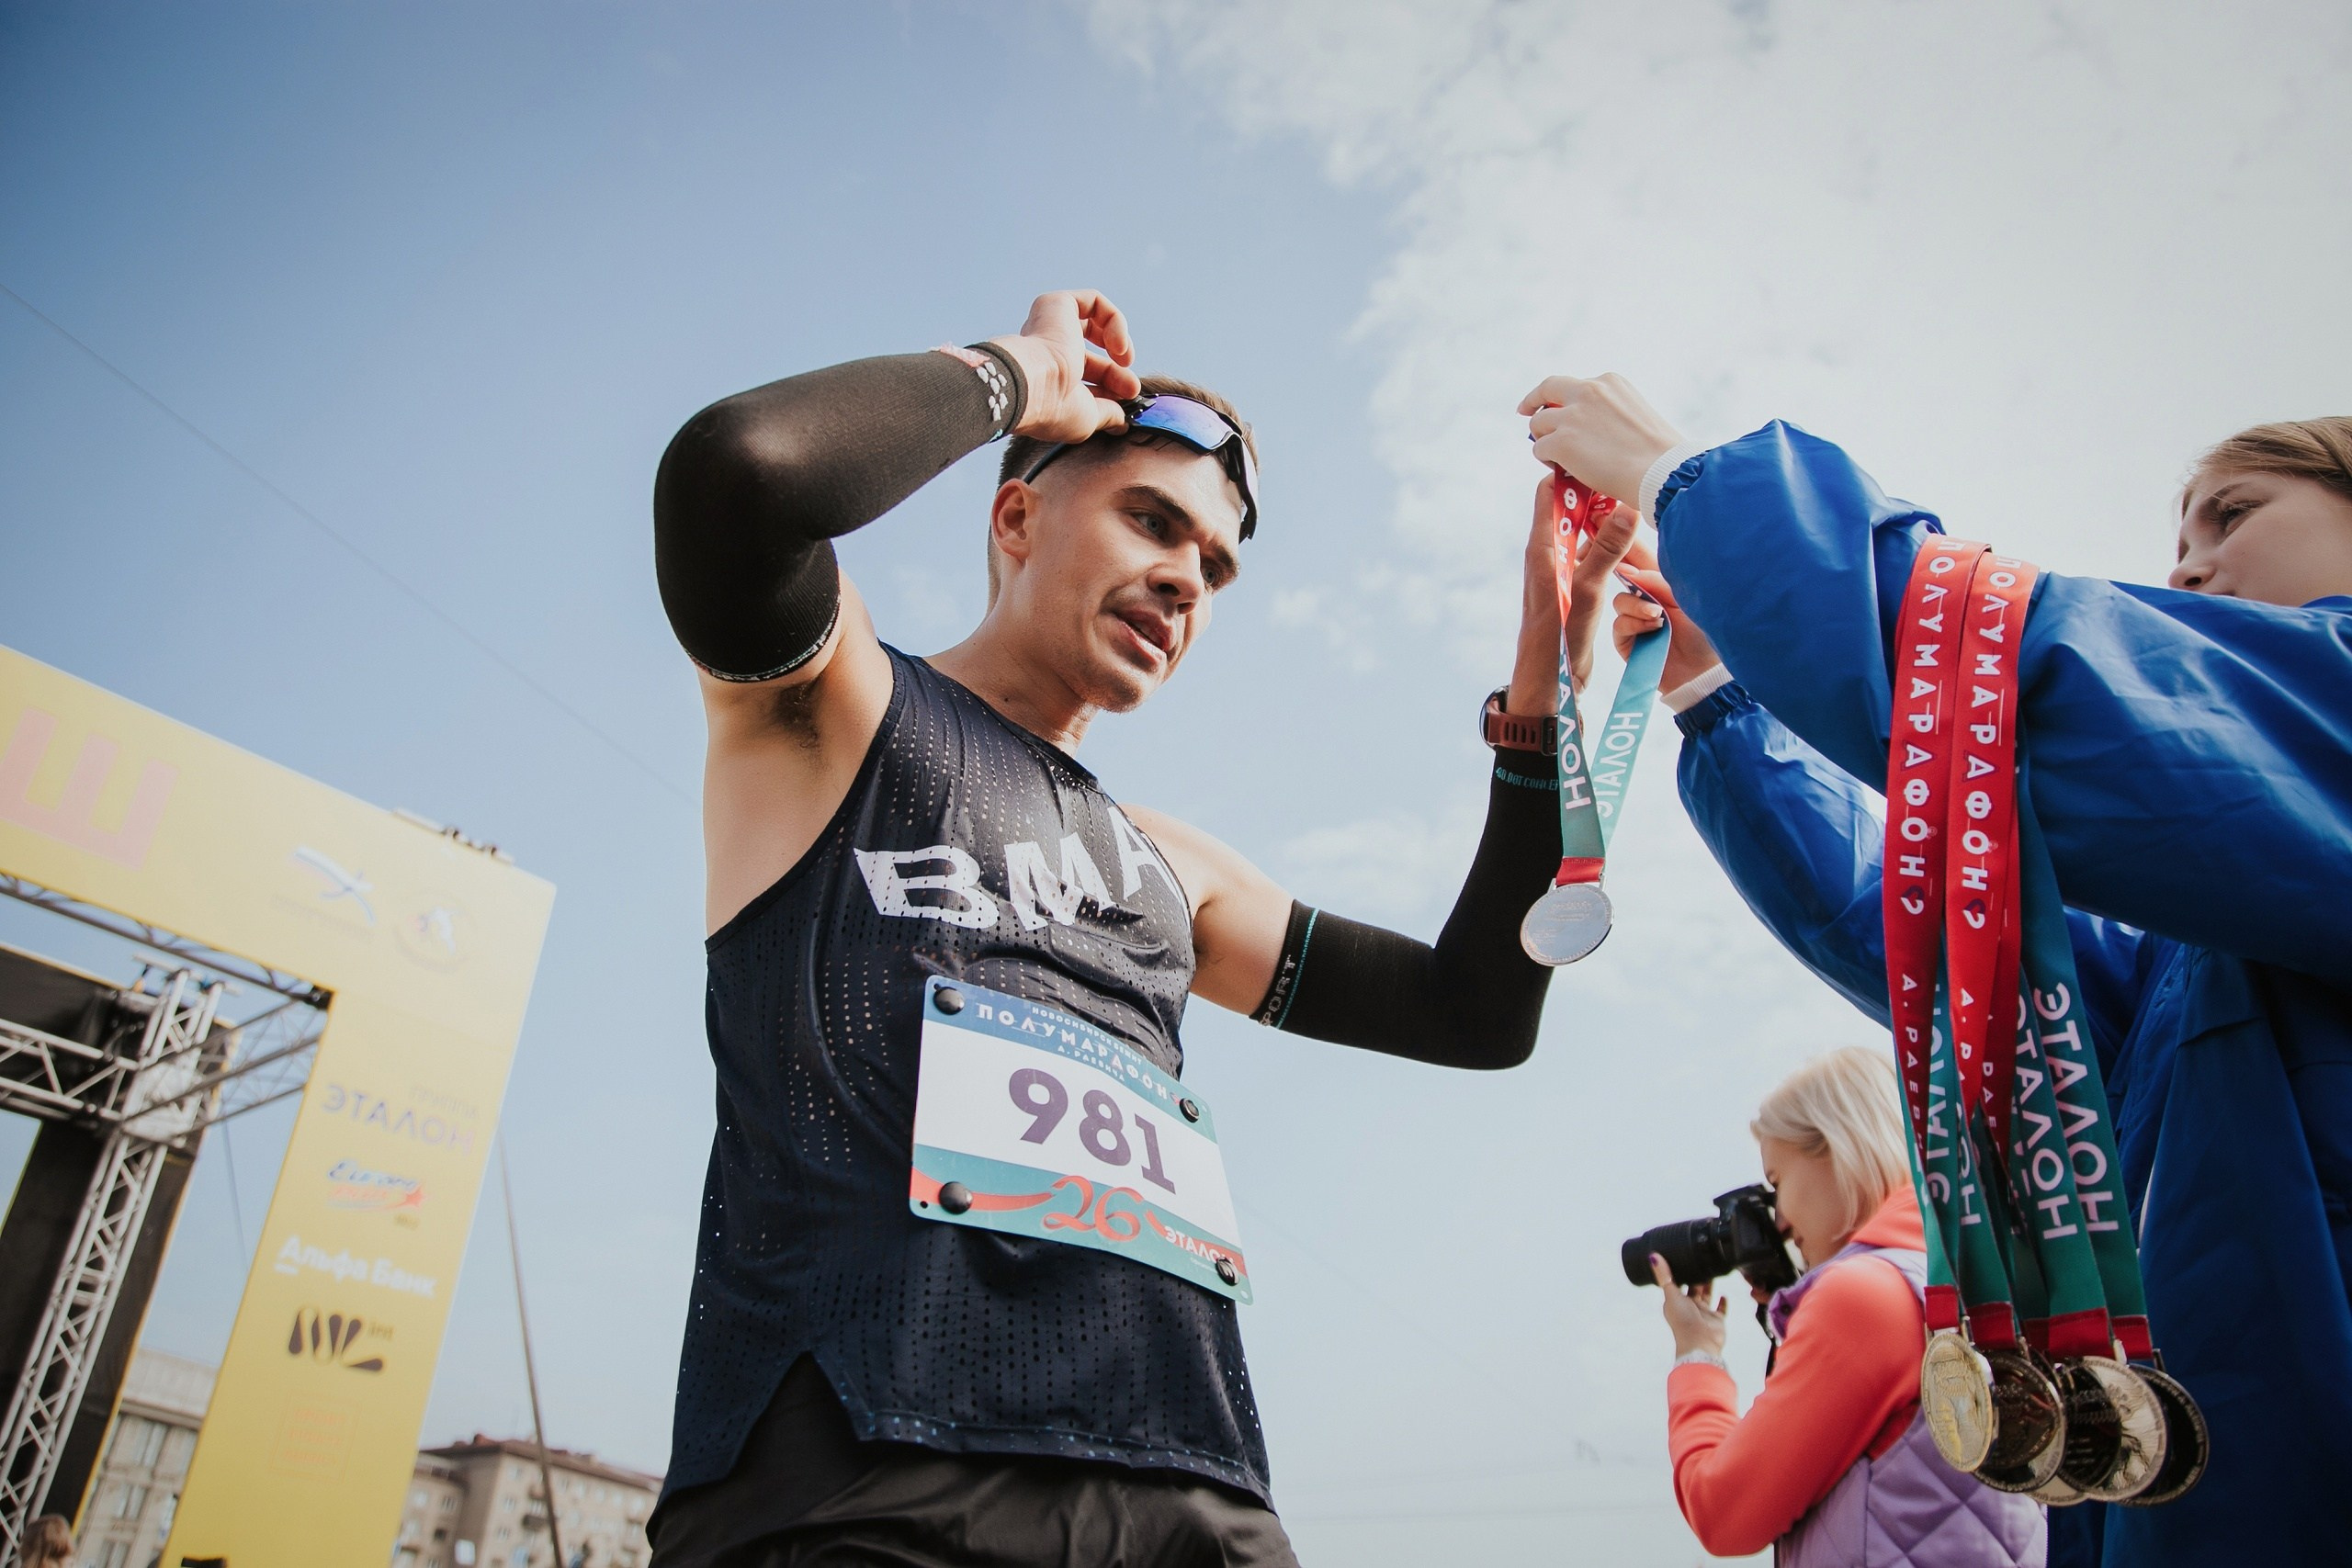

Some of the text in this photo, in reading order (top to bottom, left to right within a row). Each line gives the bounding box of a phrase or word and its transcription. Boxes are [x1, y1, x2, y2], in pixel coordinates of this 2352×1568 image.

[1559, 633, 1592, 810] ТАЛОН
[1900, 538, 1965, 877] ПОЛУМАРАФОН
[1962, 555, 2021, 890] ПОЛУМАРАФОН
[978, 1002, 1168, 1100] ПОЛУМАРАФОН
[1032, 1006, 1113, 1046] НОВОСИБИРСК
[321, 1082, 476, 1158] ЭТАЛОН
[1009, 1067, 1176, 1195] 981
[2032, 981, 2119, 1232] ЭТАЛОН
[1043, 1175, 1144, 1242] 26
[276, 1235, 437, 1300] Альфа Банк
